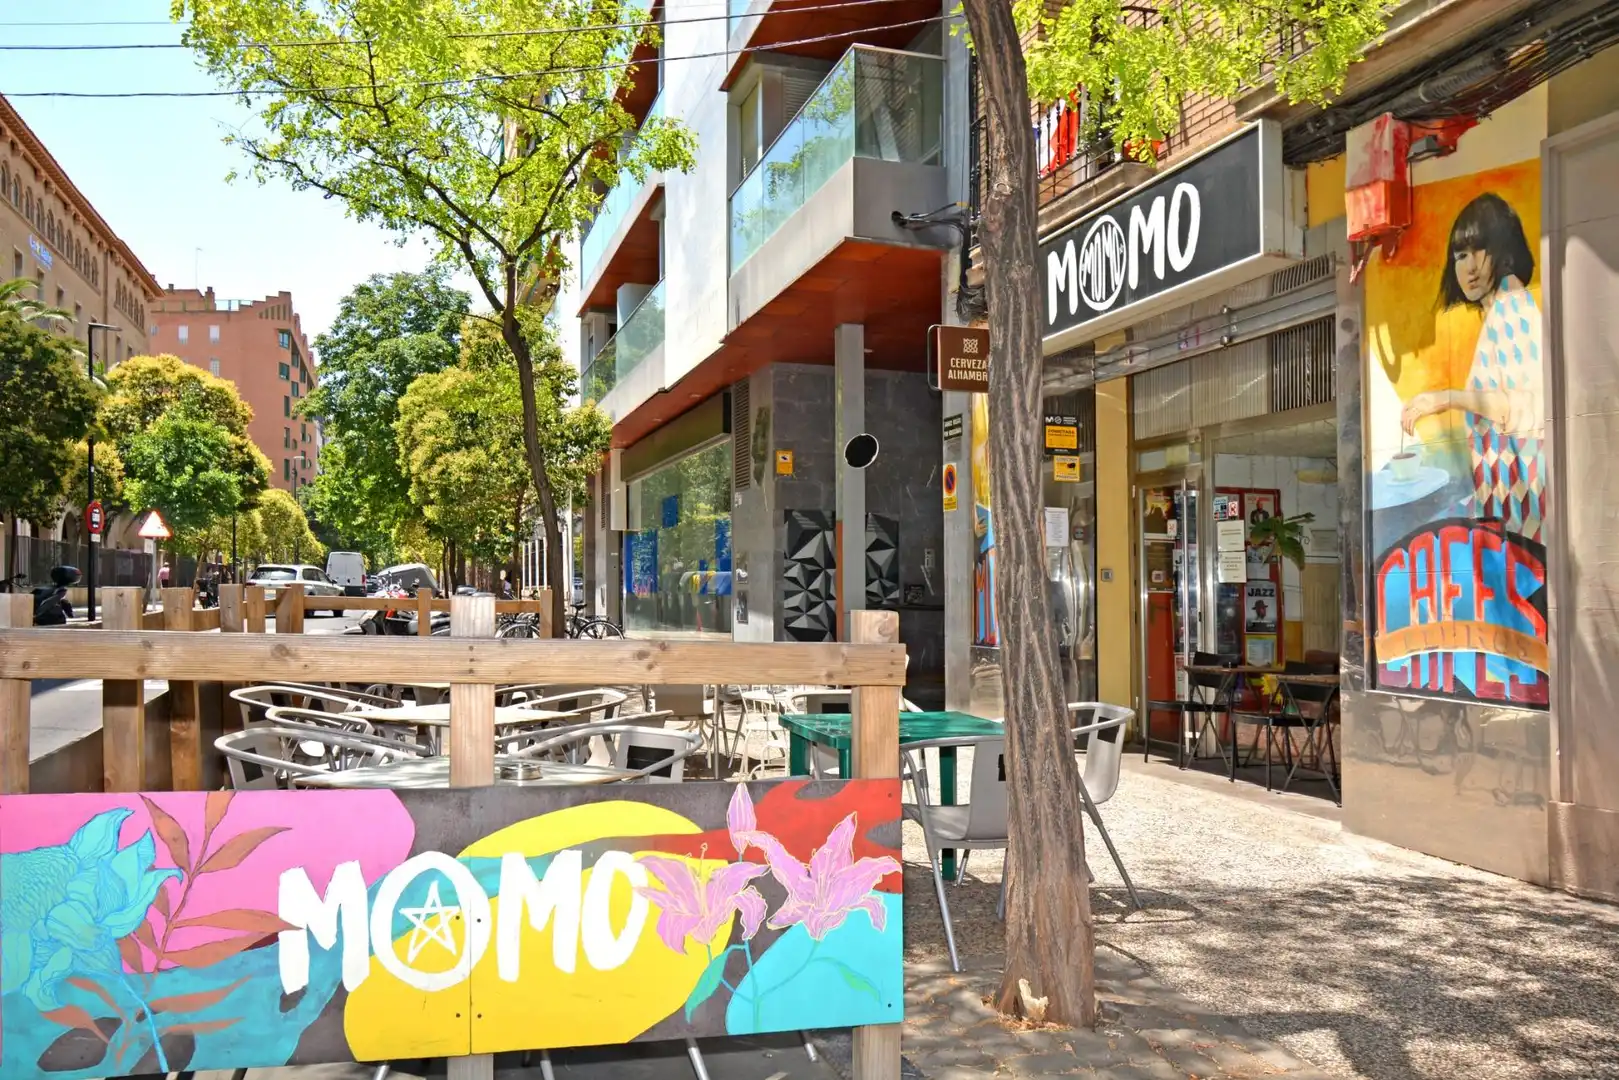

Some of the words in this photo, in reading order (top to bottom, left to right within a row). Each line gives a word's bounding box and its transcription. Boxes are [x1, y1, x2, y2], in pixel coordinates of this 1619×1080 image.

[1047, 182, 1201, 326] MOMO
[950, 357, 988, 370] CERVEZA
[947, 369, 989, 382] ALHAMBR
[1247, 587, 1275, 597] JAZZ
[277, 850, 650, 995] MOMO
